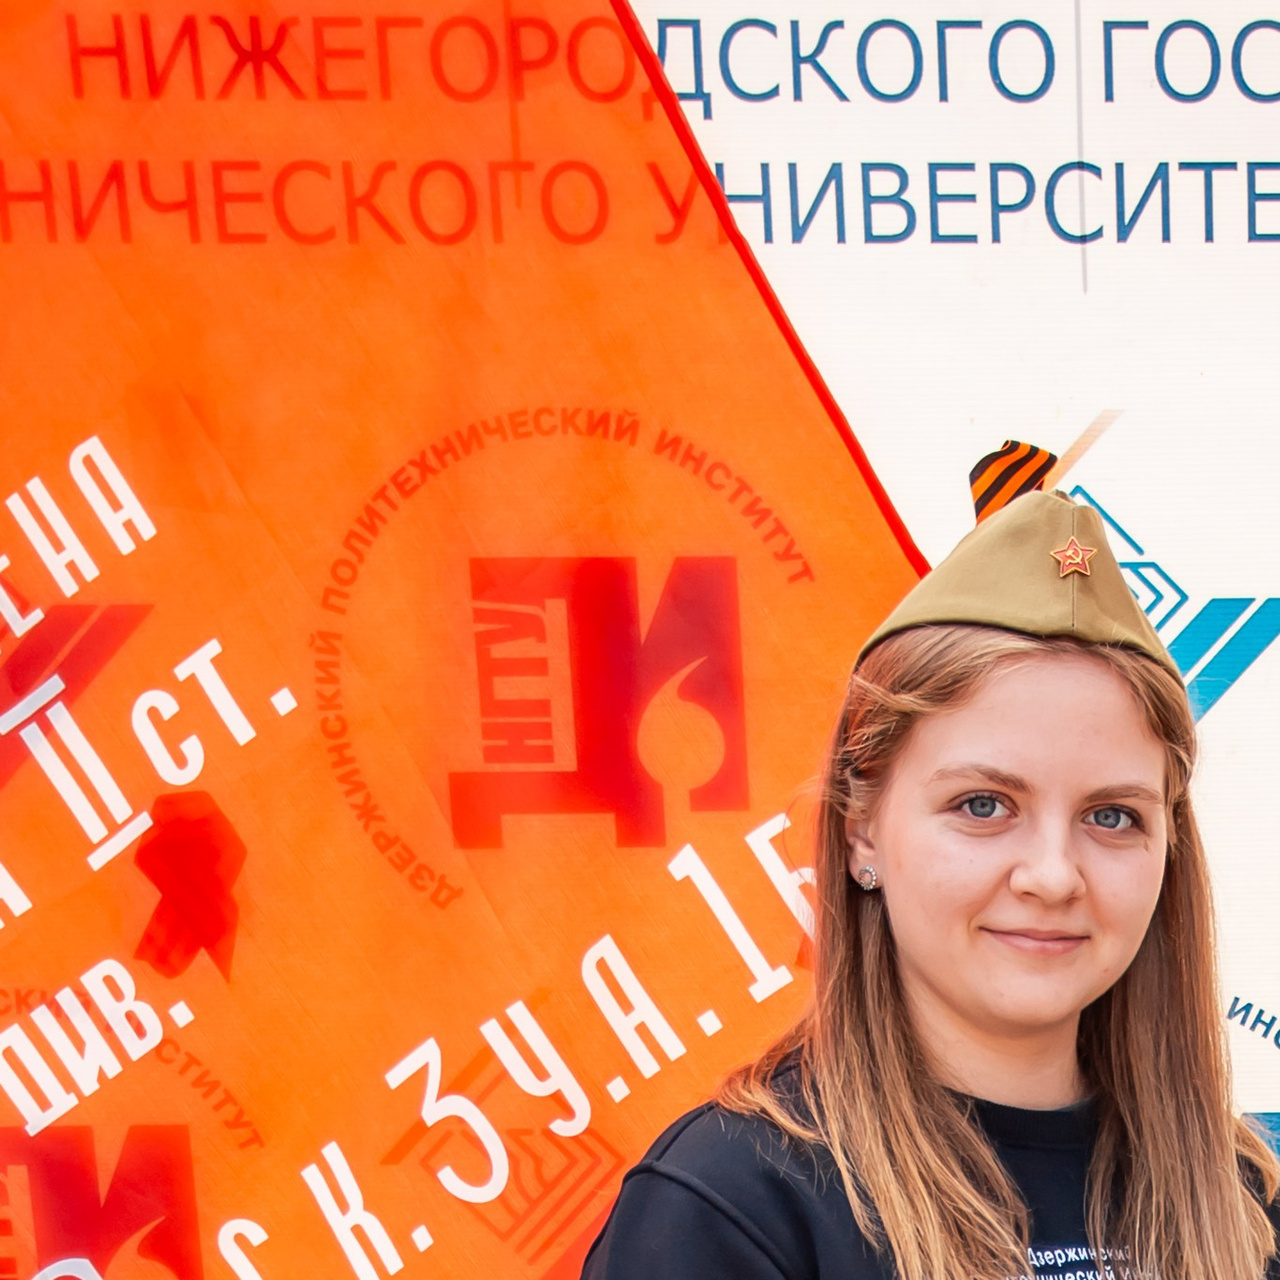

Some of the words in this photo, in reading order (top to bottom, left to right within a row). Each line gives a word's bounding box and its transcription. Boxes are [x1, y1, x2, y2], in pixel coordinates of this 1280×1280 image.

[66, 13, 1057, 120] НИЖЕГОРОДСКОГО
[321, 406, 642, 616] ПОЛИТЕХНИЧЕСКИЙ
[654, 428, 817, 587] ИНСТИТУТ
[131, 637, 298, 787] СТ.
[309, 630, 465, 911] ДЗЕРЖИНСКИЙ
[0, 958, 195, 1137] ДИВ.
